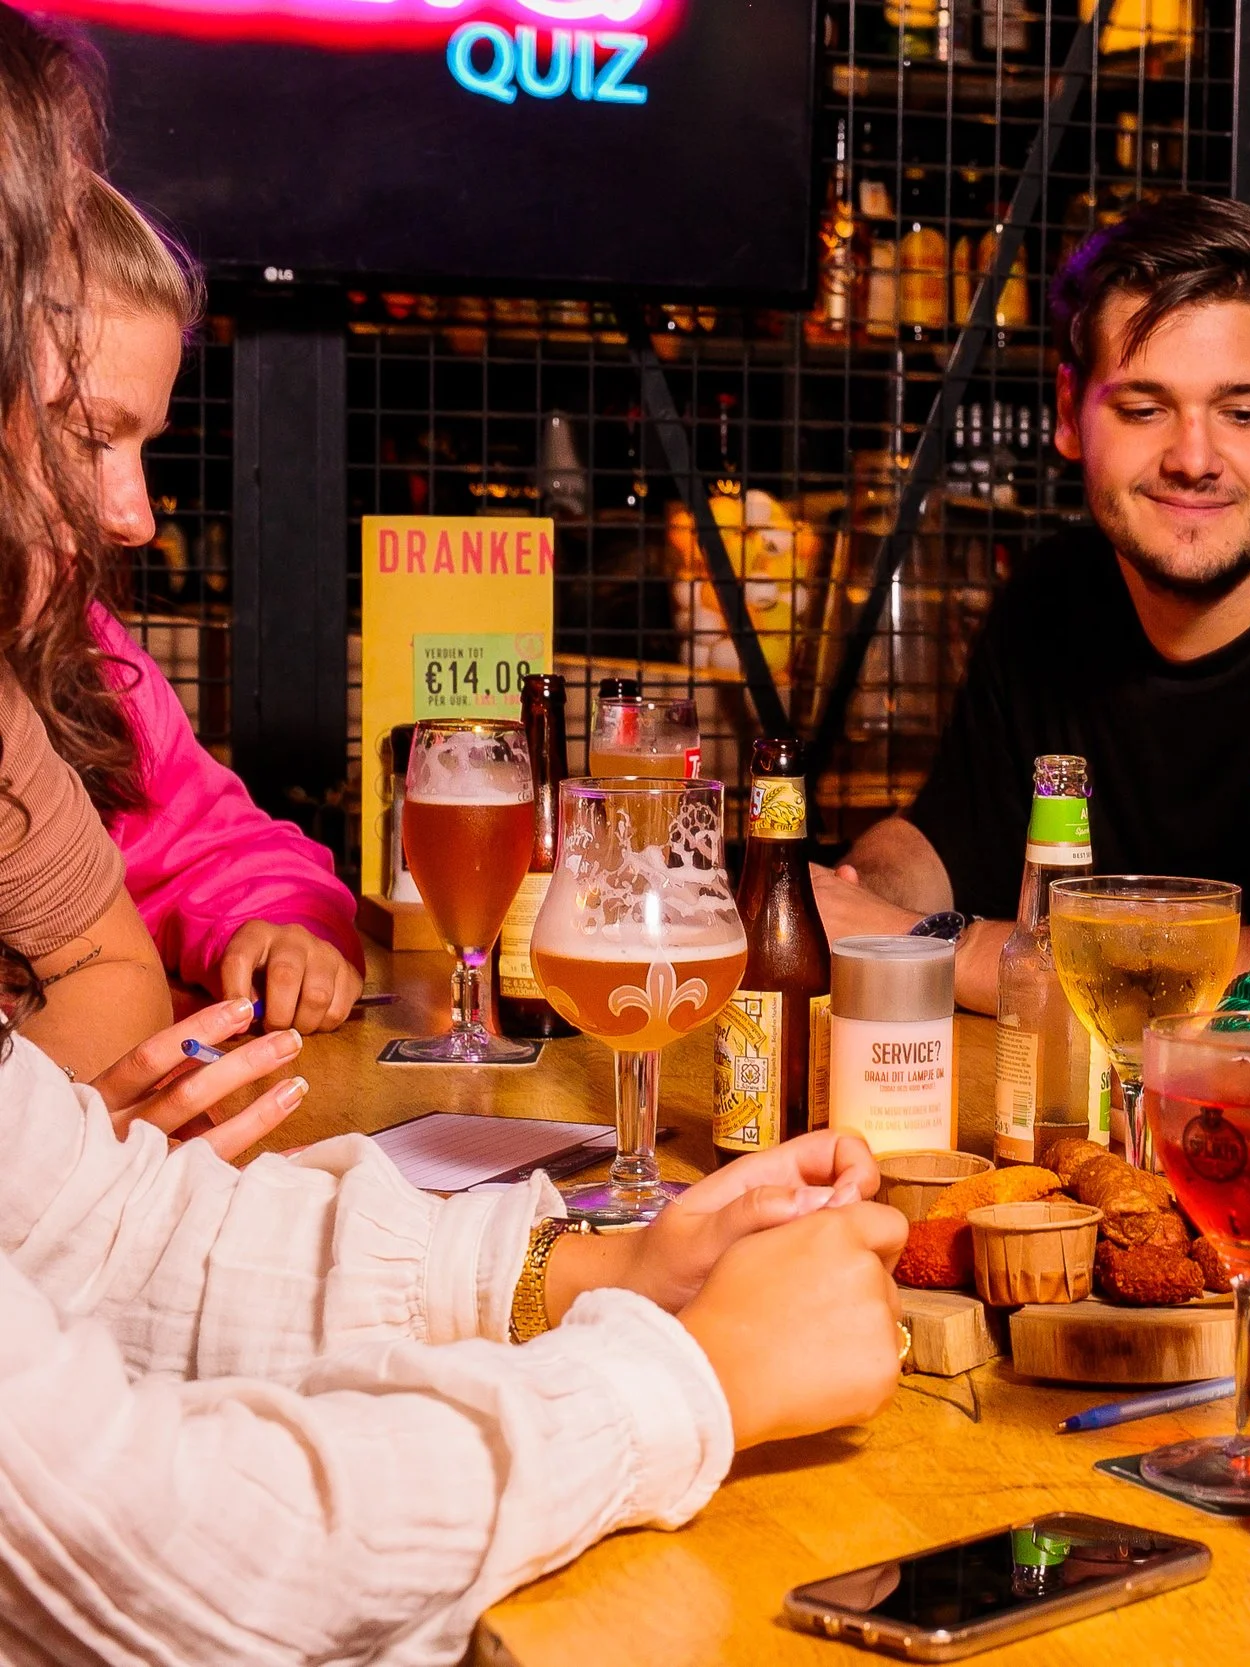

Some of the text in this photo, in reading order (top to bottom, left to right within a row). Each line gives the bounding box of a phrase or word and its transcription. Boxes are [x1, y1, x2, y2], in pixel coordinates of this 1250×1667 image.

[446, 20, 648, 104] QUIZ
[468, 647, 484, 659] TOT
[872, 1040, 941, 1065] SERVICE?
[865, 1070, 889, 1082] DRAAI
[892, 1071, 904, 1083] DIT
[908, 1069, 935, 1083] LAMPJE
